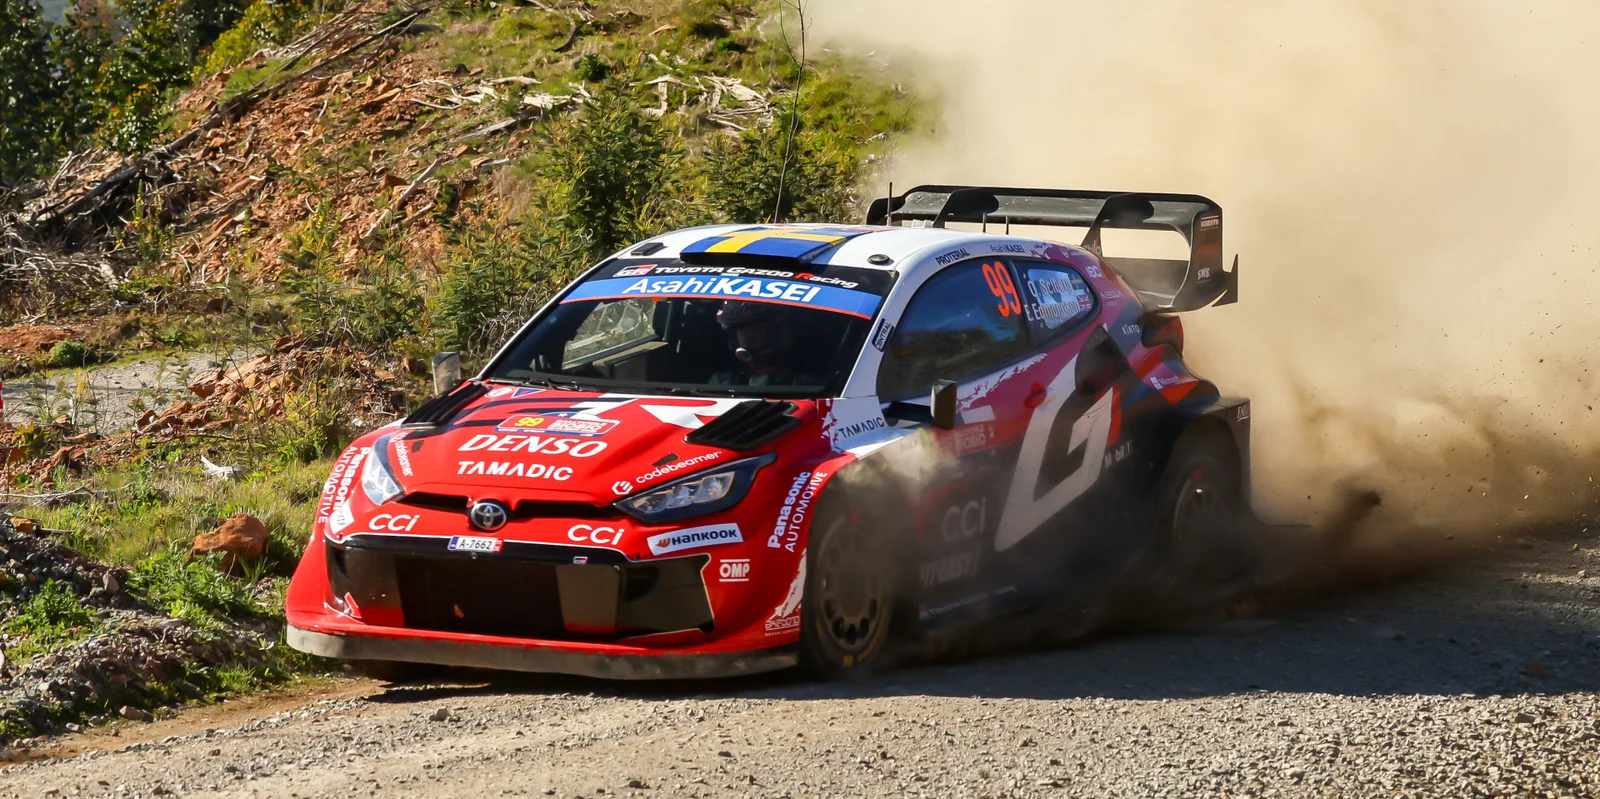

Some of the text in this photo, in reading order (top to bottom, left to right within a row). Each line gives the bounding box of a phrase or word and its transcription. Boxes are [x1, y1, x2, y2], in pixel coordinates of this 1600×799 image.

[935, 248, 971, 266] PROTERIAL
[655, 266, 724, 274] TOYOTA
[726, 266, 794, 278] GAZOO
[795, 272, 859, 289] Racing
[981, 260, 1022, 318] 99
[621, 277, 822, 303] AsahiKASEI
[875, 322, 892, 350] CENTRAL
[514, 417, 544, 427] 99
[838, 416, 885, 439] TAMADIC
[457, 434, 608, 458] DENSO
[457, 461, 573, 481] TAMADIC
[636, 451, 722, 484] codebeamer
[318, 446, 358, 524] AUTOMOTIVE
[767, 471, 811, 549] Panasonic
[784, 471, 828, 553] AUTOMOTIVE
[459, 539, 493, 550] A-7662
[719, 563, 750, 578] OMP
